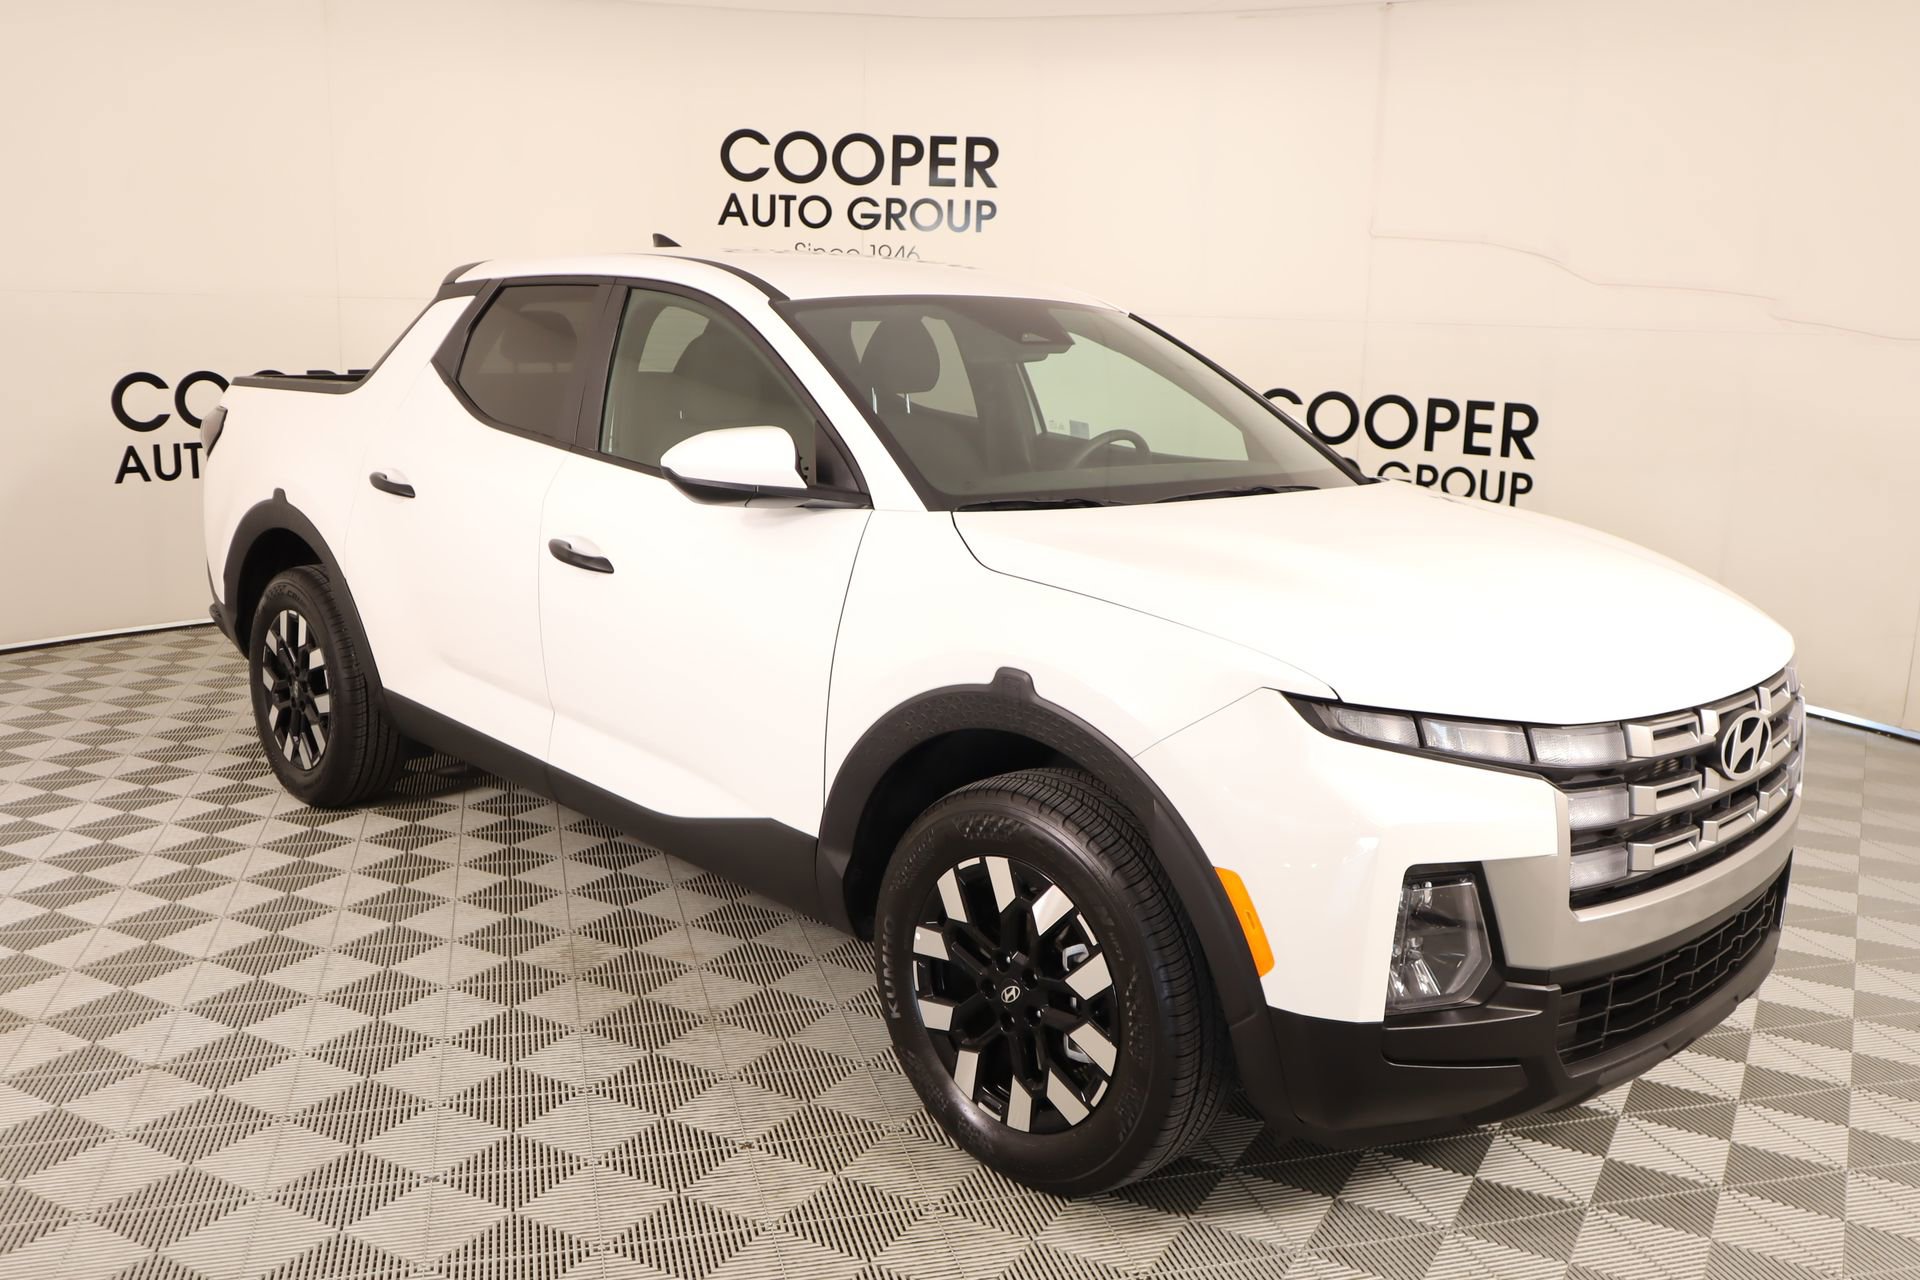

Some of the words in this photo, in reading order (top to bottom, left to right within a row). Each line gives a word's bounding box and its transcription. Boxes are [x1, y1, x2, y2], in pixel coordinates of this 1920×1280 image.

[720, 128, 999, 188] COOPER
[717, 193, 832, 229] AUTO
[847, 196, 997, 233] GROUP
[114, 442, 203, 484] AUT
[883, 916, 901, 1018] KUMHO
